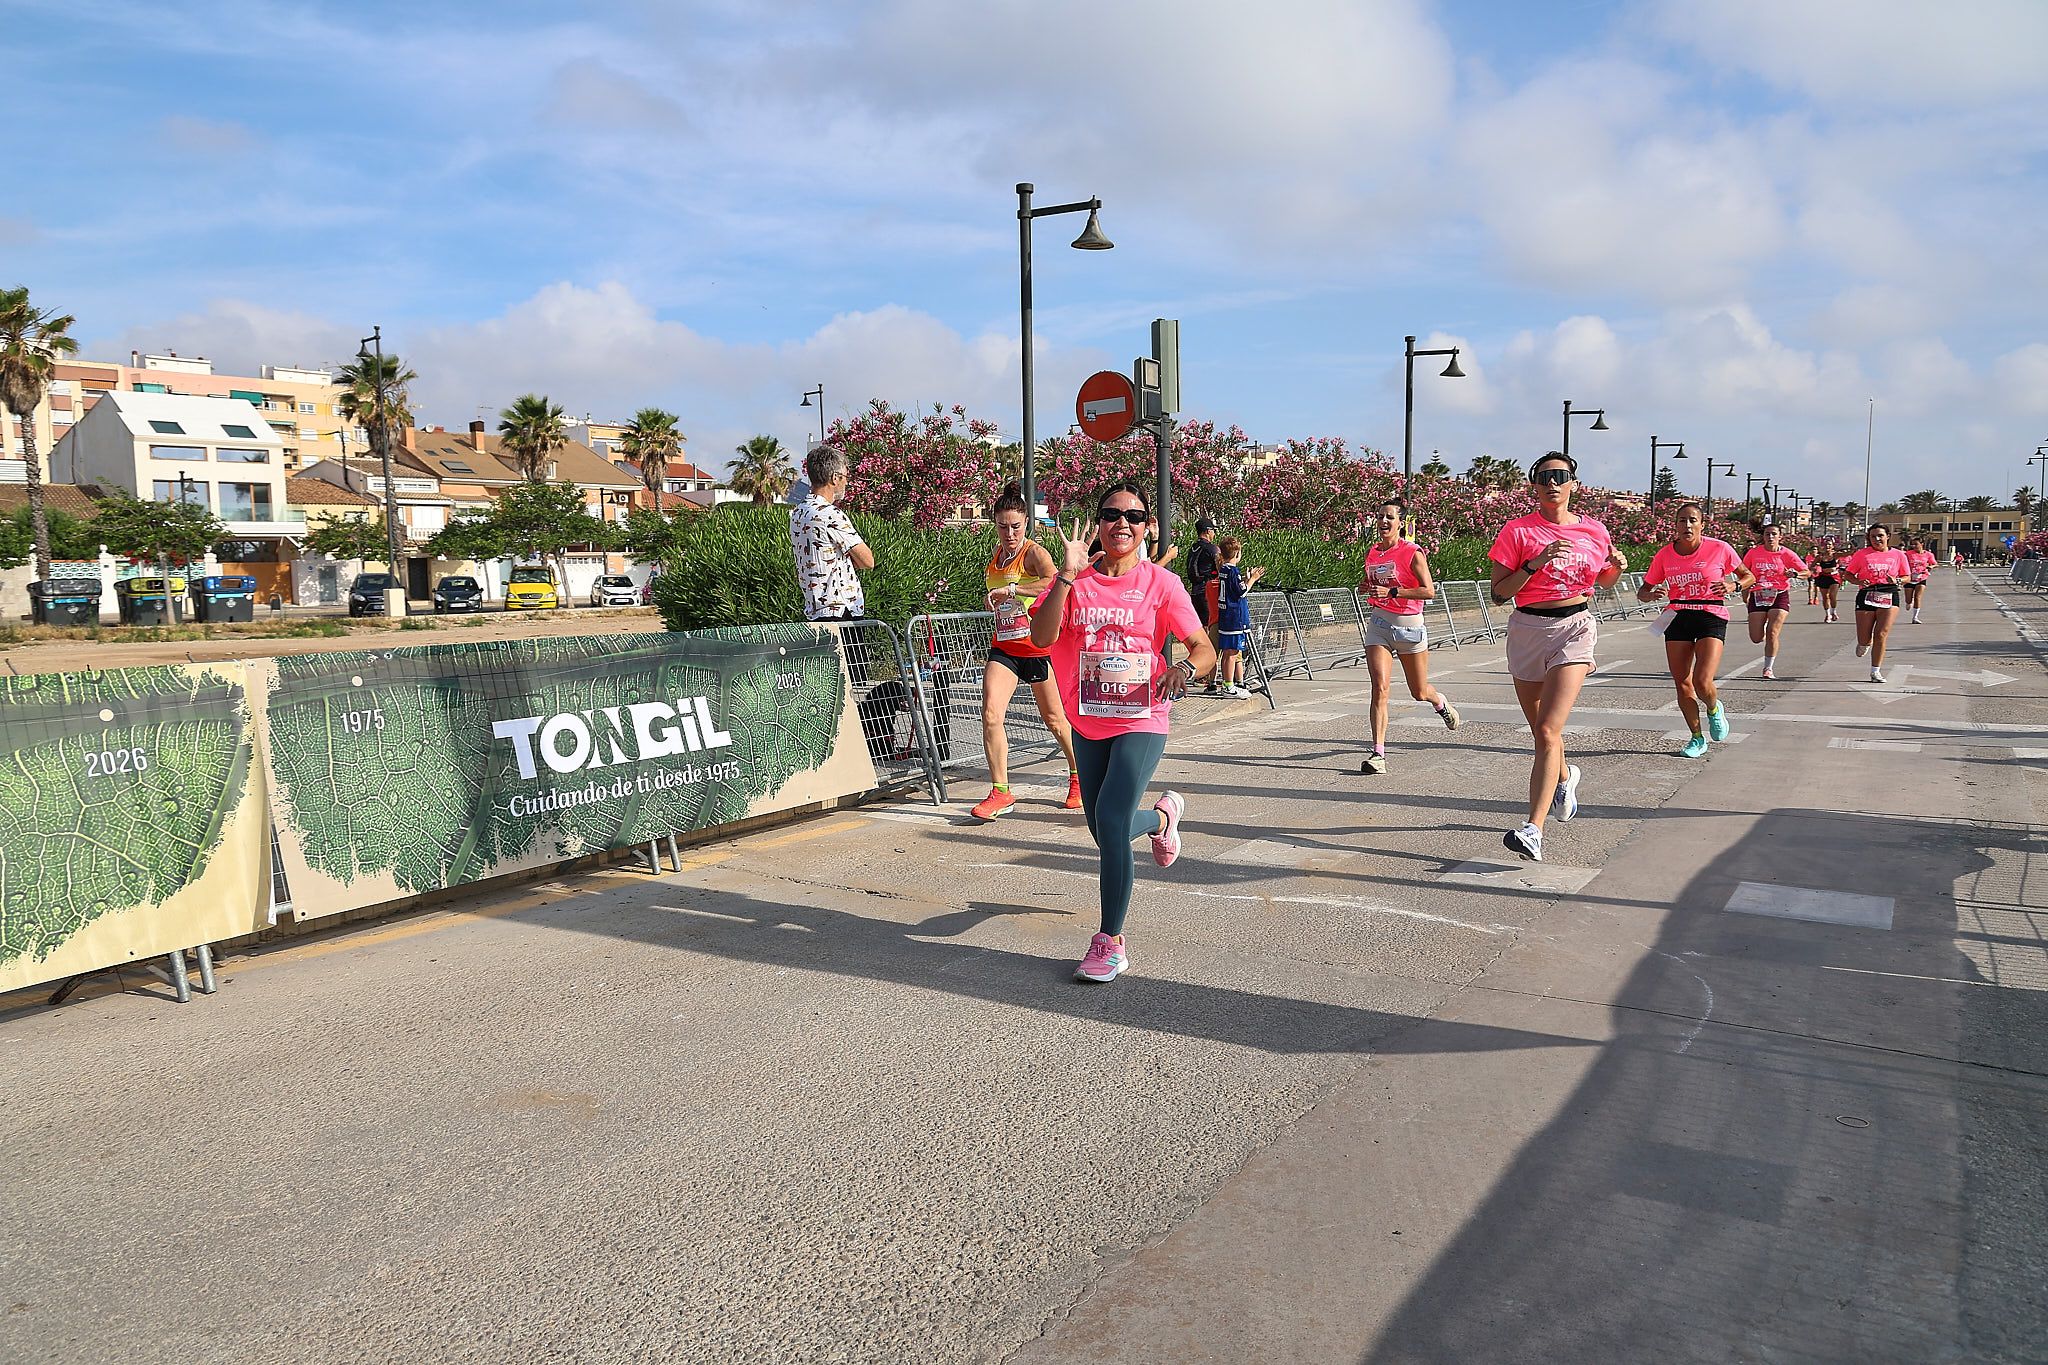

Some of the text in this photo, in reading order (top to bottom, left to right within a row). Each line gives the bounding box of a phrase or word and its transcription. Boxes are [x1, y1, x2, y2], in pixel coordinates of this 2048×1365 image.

[1667, 572, 1703, 585] CARRERA
[1073, 607, 1135, 626] CARRERA
[776, 672, 802, 690] 2026
[1101, 682, 1128, 694] 016
[340, 708, 385, 734] 1975
[85, 747, 148, 777] 2026
[509, 761, 740, 818] Cuidando de ti desde 1975
